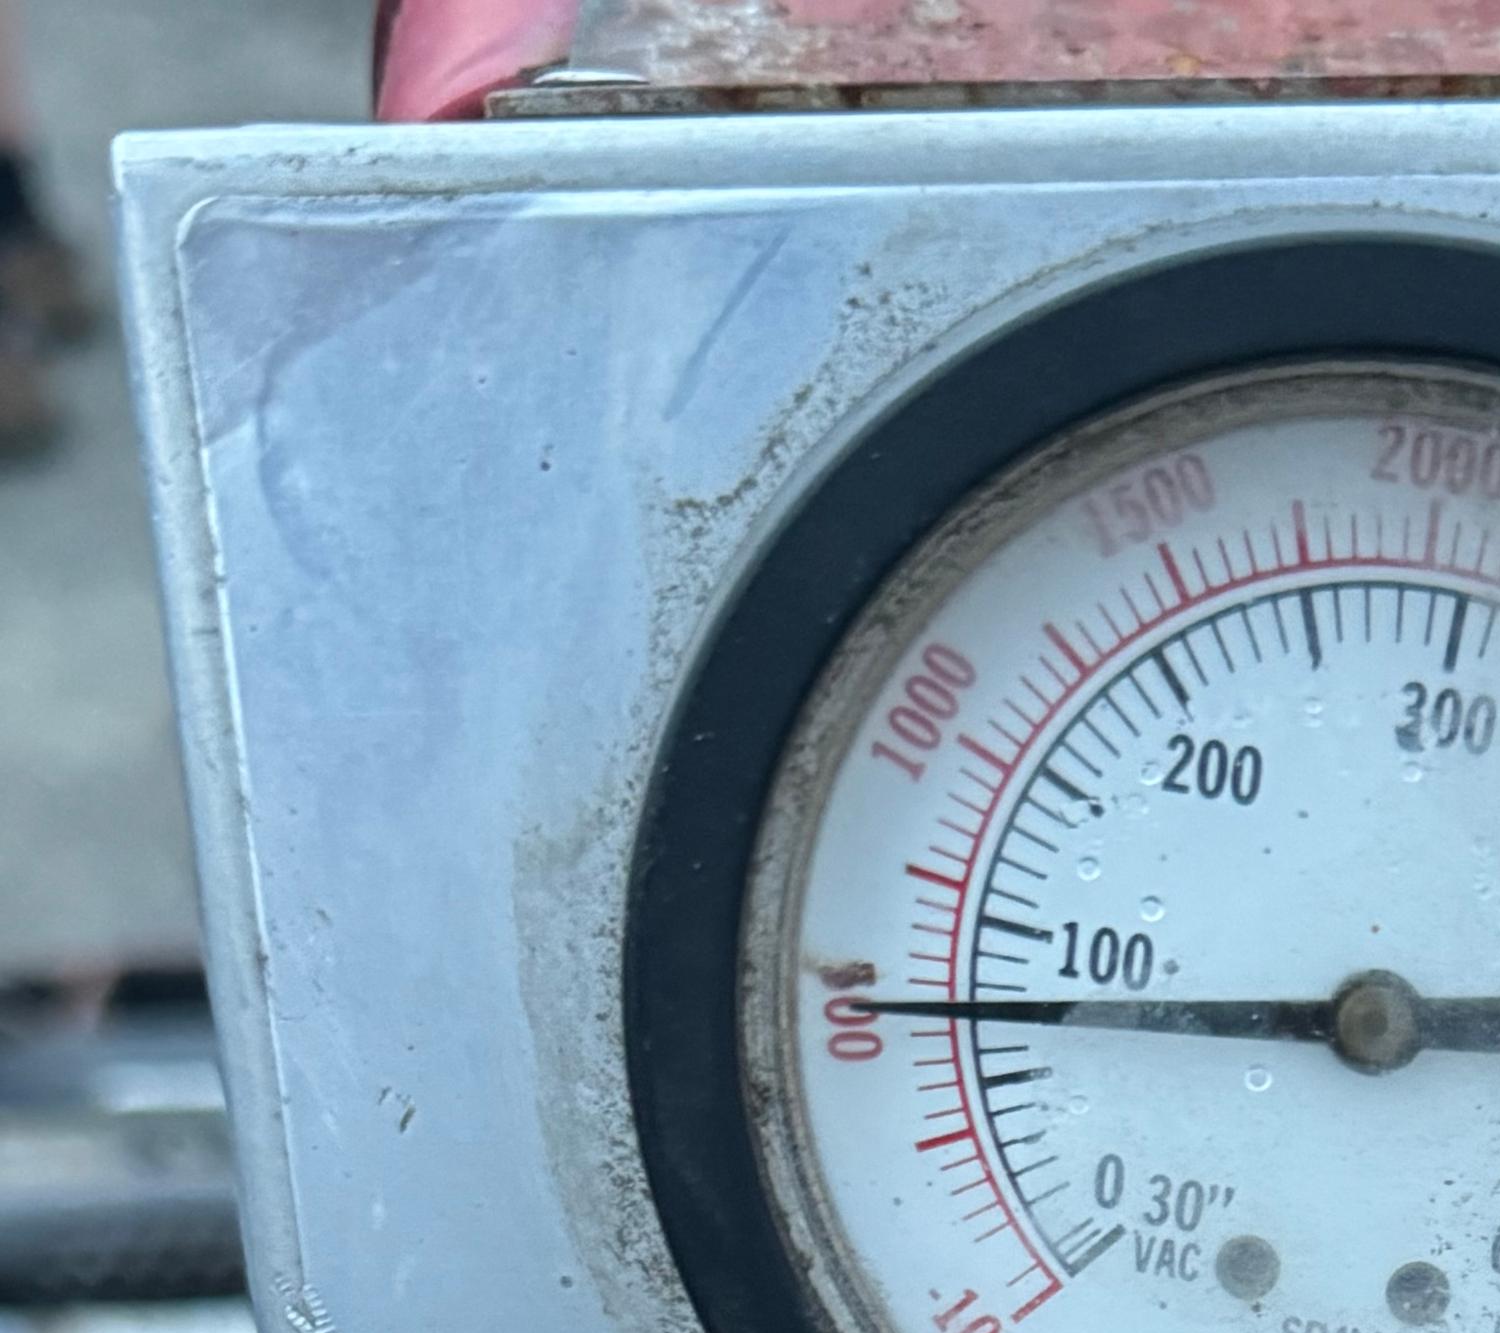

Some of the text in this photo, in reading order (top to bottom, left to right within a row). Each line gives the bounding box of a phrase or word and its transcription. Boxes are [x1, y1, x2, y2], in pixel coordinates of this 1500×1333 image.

[1080, 454, 1215, 558] 1500
[871, 642, 977, 781] 1000
[1396, 681, 1497, 755] 300
[1162, 734, 1262, 805] 200
[1058, 921, 1154, 990] 100
[1094, 1154, 1125, 1209] 0
[1133, 1231, 1200, 1282] VAC
